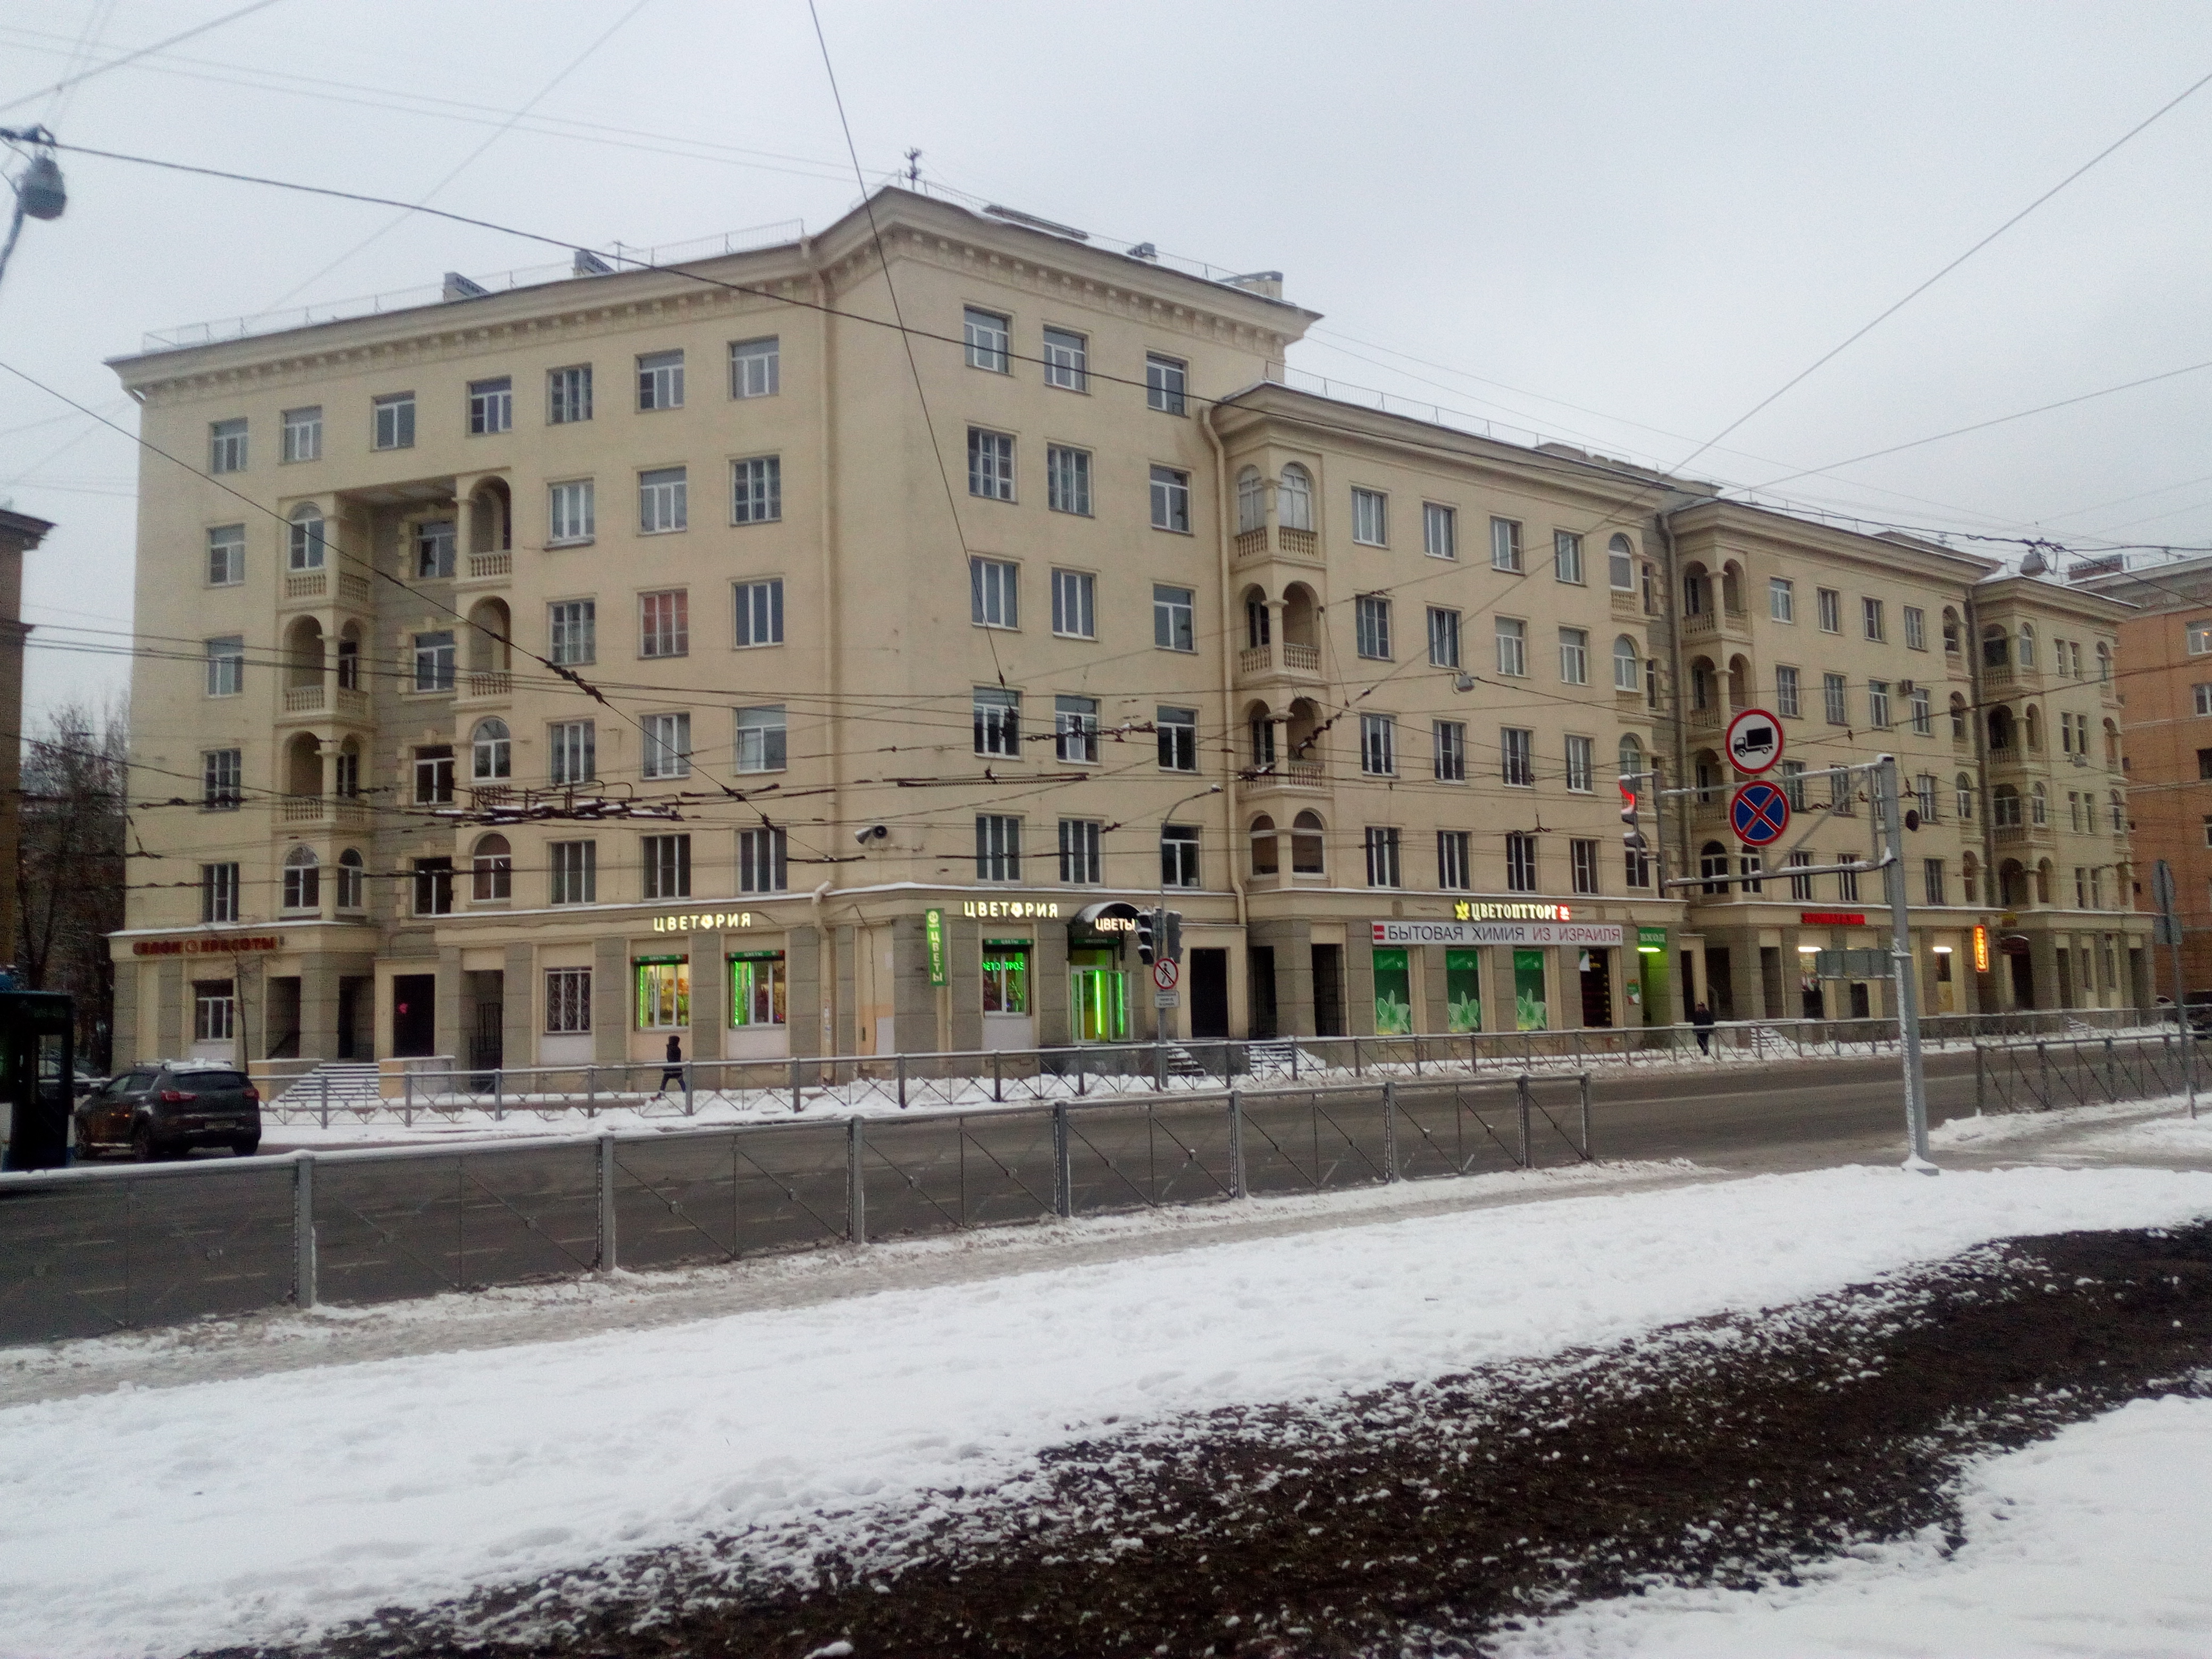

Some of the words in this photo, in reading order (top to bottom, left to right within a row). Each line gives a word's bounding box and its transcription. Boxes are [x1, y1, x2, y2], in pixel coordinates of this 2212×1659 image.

[1471, 903, 1558, 921] ЦВЕТОПТТОРГ
[1095, 917, 1136, 932] ЦВЕТЫ
[1388, 925, 1464, 941] БЫТОВАЯ
[1471, 926, 1525, 941] ХИМИЯ
[1532, 926, 1552, 941] ИЗ
[1558, 927, 1621, 942] ИЗРАИЛЯ
[931, 930, 943, 982] ЦВЕТЫ
